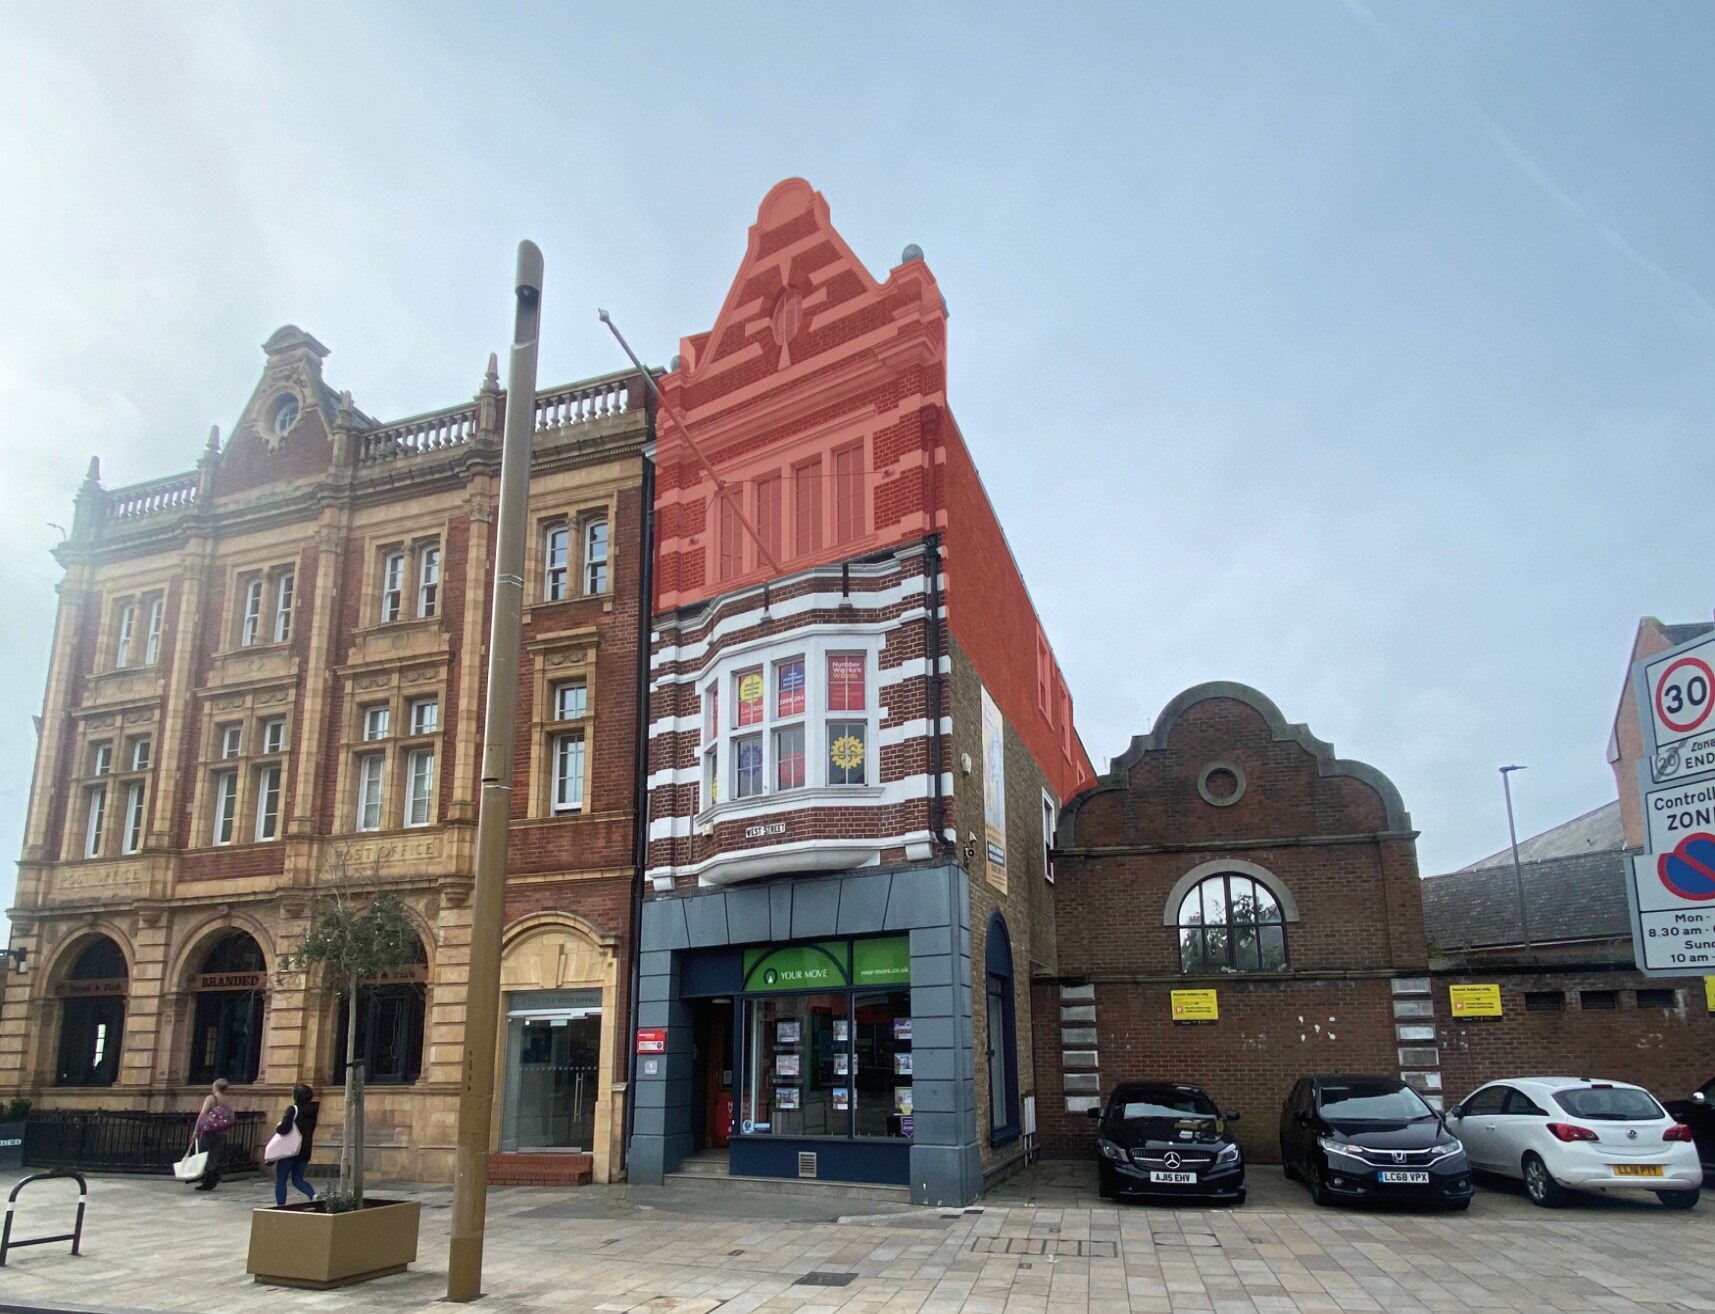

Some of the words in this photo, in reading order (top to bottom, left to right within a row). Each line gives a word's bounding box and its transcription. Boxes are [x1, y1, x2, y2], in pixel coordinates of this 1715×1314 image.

[1664, 675, 1707, 714] 30
[1667, 806, 1715, 831] ZON
[746, 827, 762, 837] WEST
[763, 823, 785, 835] STREET
[379, 842, 433, 859] OFFICE
[96, 868, 140, 884] OFFICE
[1675, 914, 1703, 923] Mon
[1648, 927, 1680, 937] 8.30
[1671, 953, 1686, 963] 10
[1689, 954, 1709, 962] am
[780, 970, 803, 980] YOUR
[804, 969, 828, 978] MOVE
[860, 966, 909, 977] your-move.co.uk
[202, 975, 260, 988] BRANDED
[1155, 1173, 1173, 1182] AJ15
[1384, 1172, 1408, 1181] LC68
[1410, 1173, 1428, 1182] VPX
